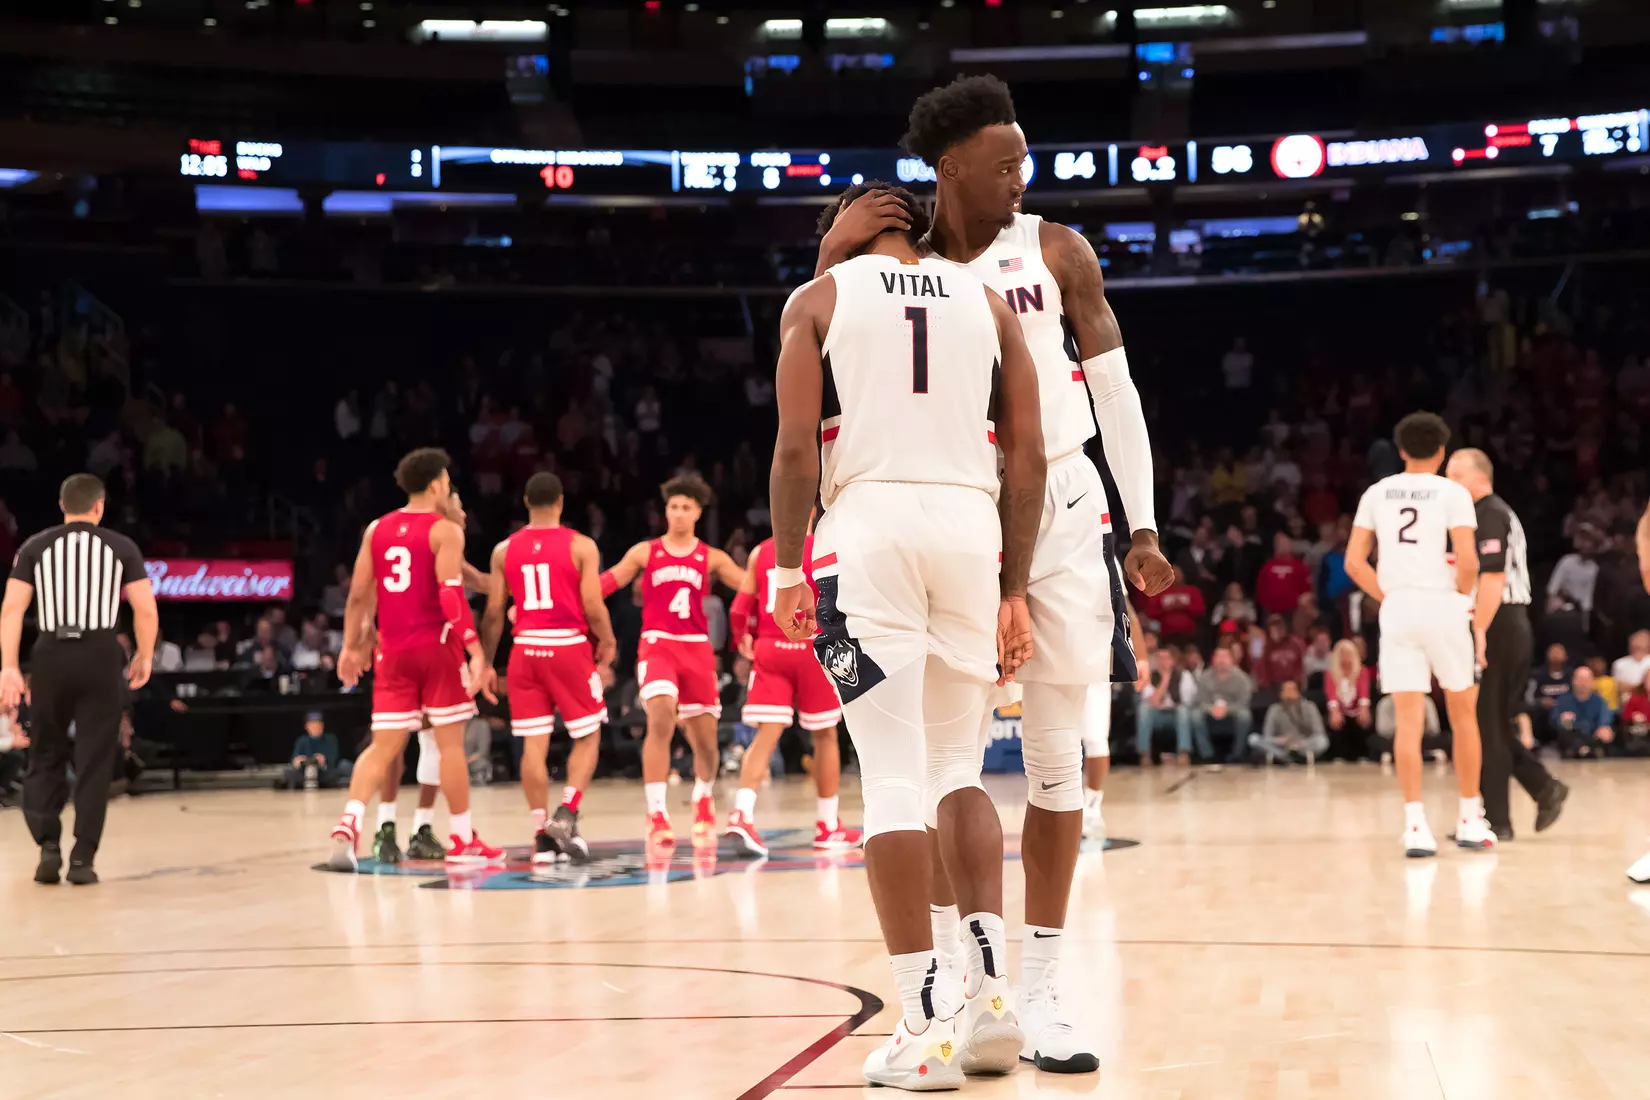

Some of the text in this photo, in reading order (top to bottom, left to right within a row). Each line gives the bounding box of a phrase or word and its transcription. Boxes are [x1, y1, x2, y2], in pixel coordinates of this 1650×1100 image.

[1326, 136, 1429, 166] INDIANA
[540, 165, 574, 188] 10
[879, 271, 950, 298] VITAL
[904, 306, 929, 394] 1
[1398, 507, 1418, 544] 2
[143, 560, 290, 597] Budweiser
[383, 546, 412, 593] 3
[521, 562, 554, 610] 11
[668, 587, 691, 620] 4
